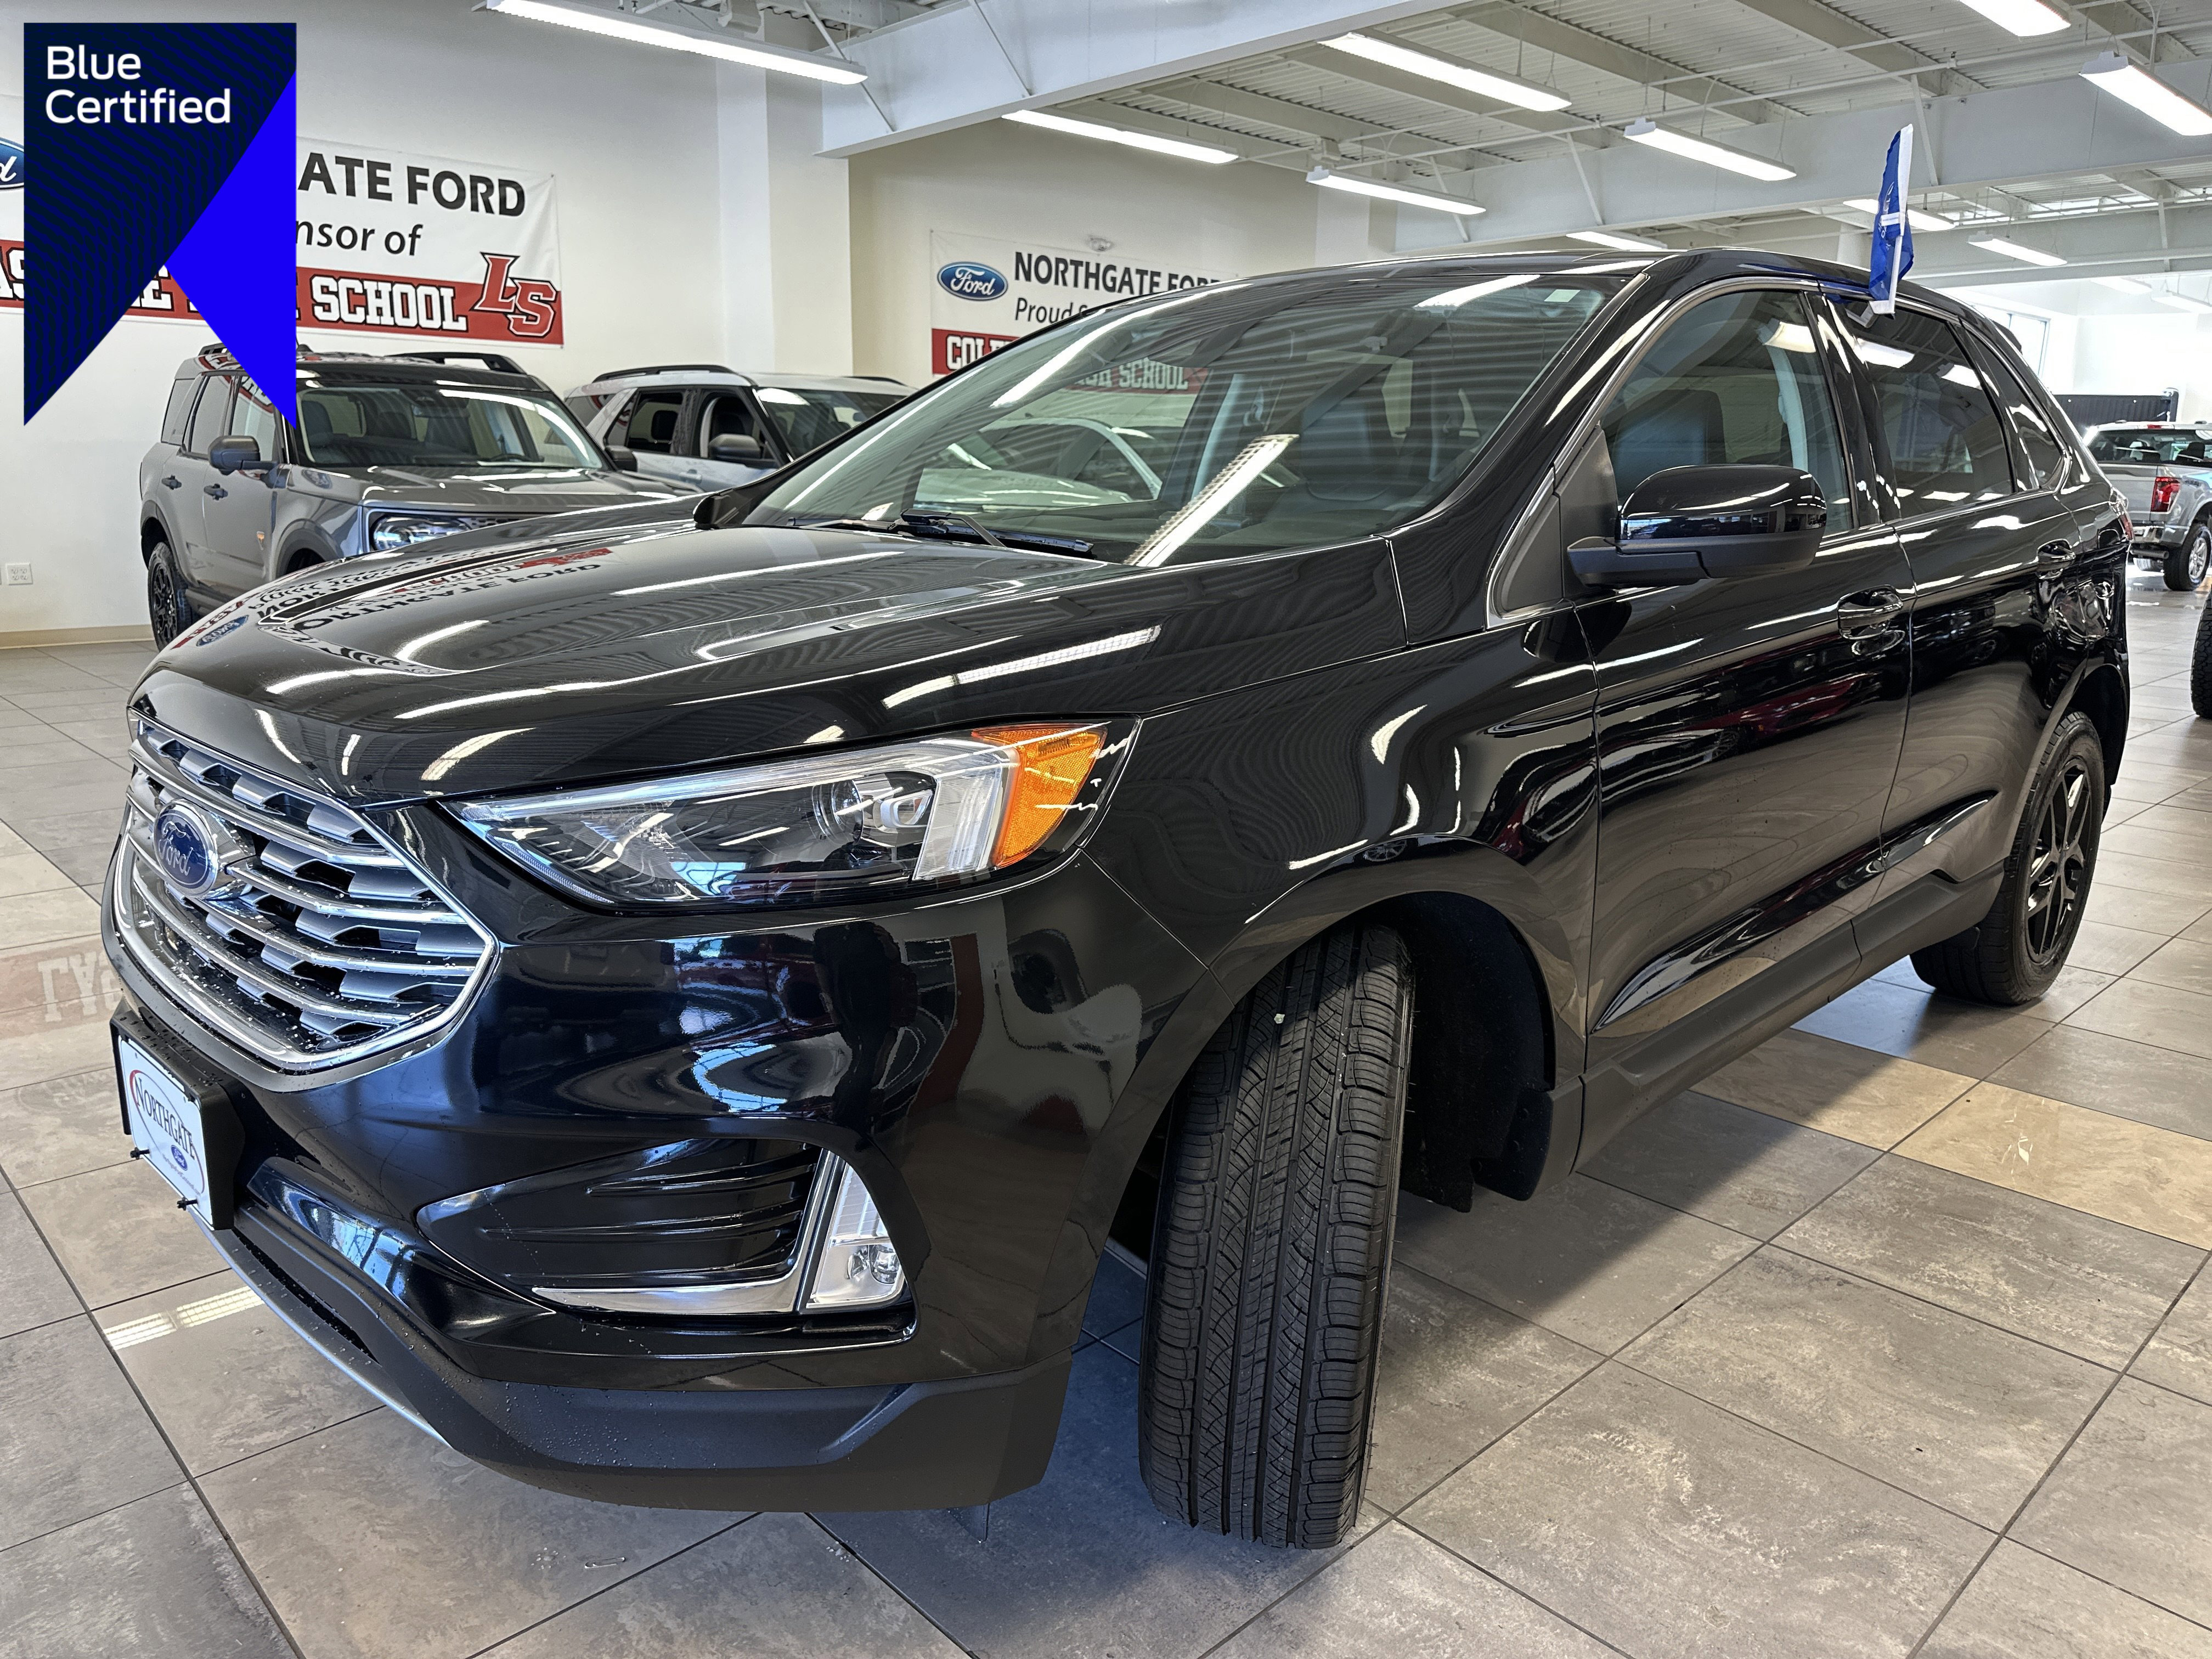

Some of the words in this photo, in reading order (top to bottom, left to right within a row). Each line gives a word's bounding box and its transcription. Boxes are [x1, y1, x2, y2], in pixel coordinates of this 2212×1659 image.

[407, 166, 526, 217] FORD
[296, 219, 375, 252] nsor
[385, 223, 424, 256] of
[950, 267, 995, 296] Ford
[1014, 251, 1161, 295] NORTHGATE
[311, 275, 467, 331] SCHOOL
[1015, 297, 1074, 324] Proud
[158, 821, 194, 876] Ford
[134, 1077, 196, 1159] NORTHGATE
